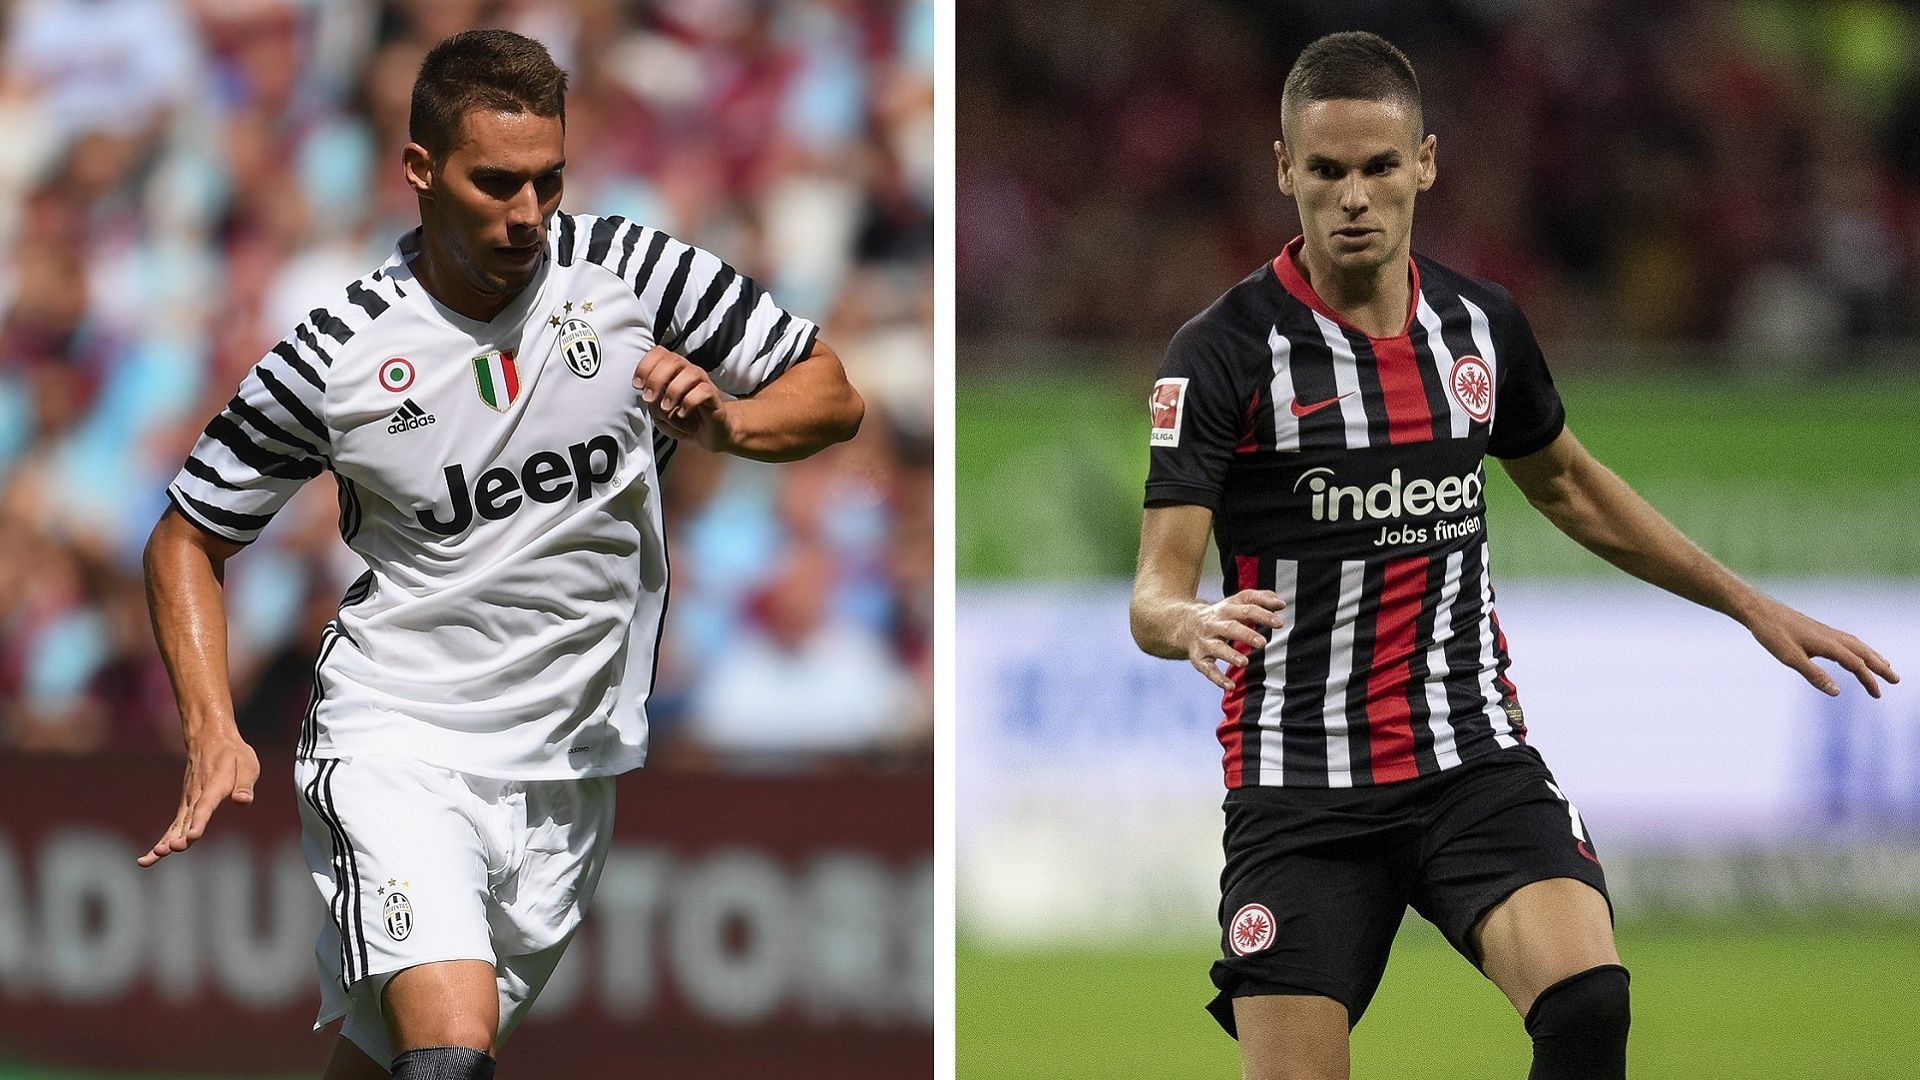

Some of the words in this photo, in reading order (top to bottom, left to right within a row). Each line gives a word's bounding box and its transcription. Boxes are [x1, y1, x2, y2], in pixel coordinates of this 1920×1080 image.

[387, 414, 436, 434] adidas
[415, 434, 619, 535] Jeep
[1309, 459, 1483, 522] indeed
[1373, 524, 1428, 547] Jobs
[1433, 515, 1481, 541] finden
